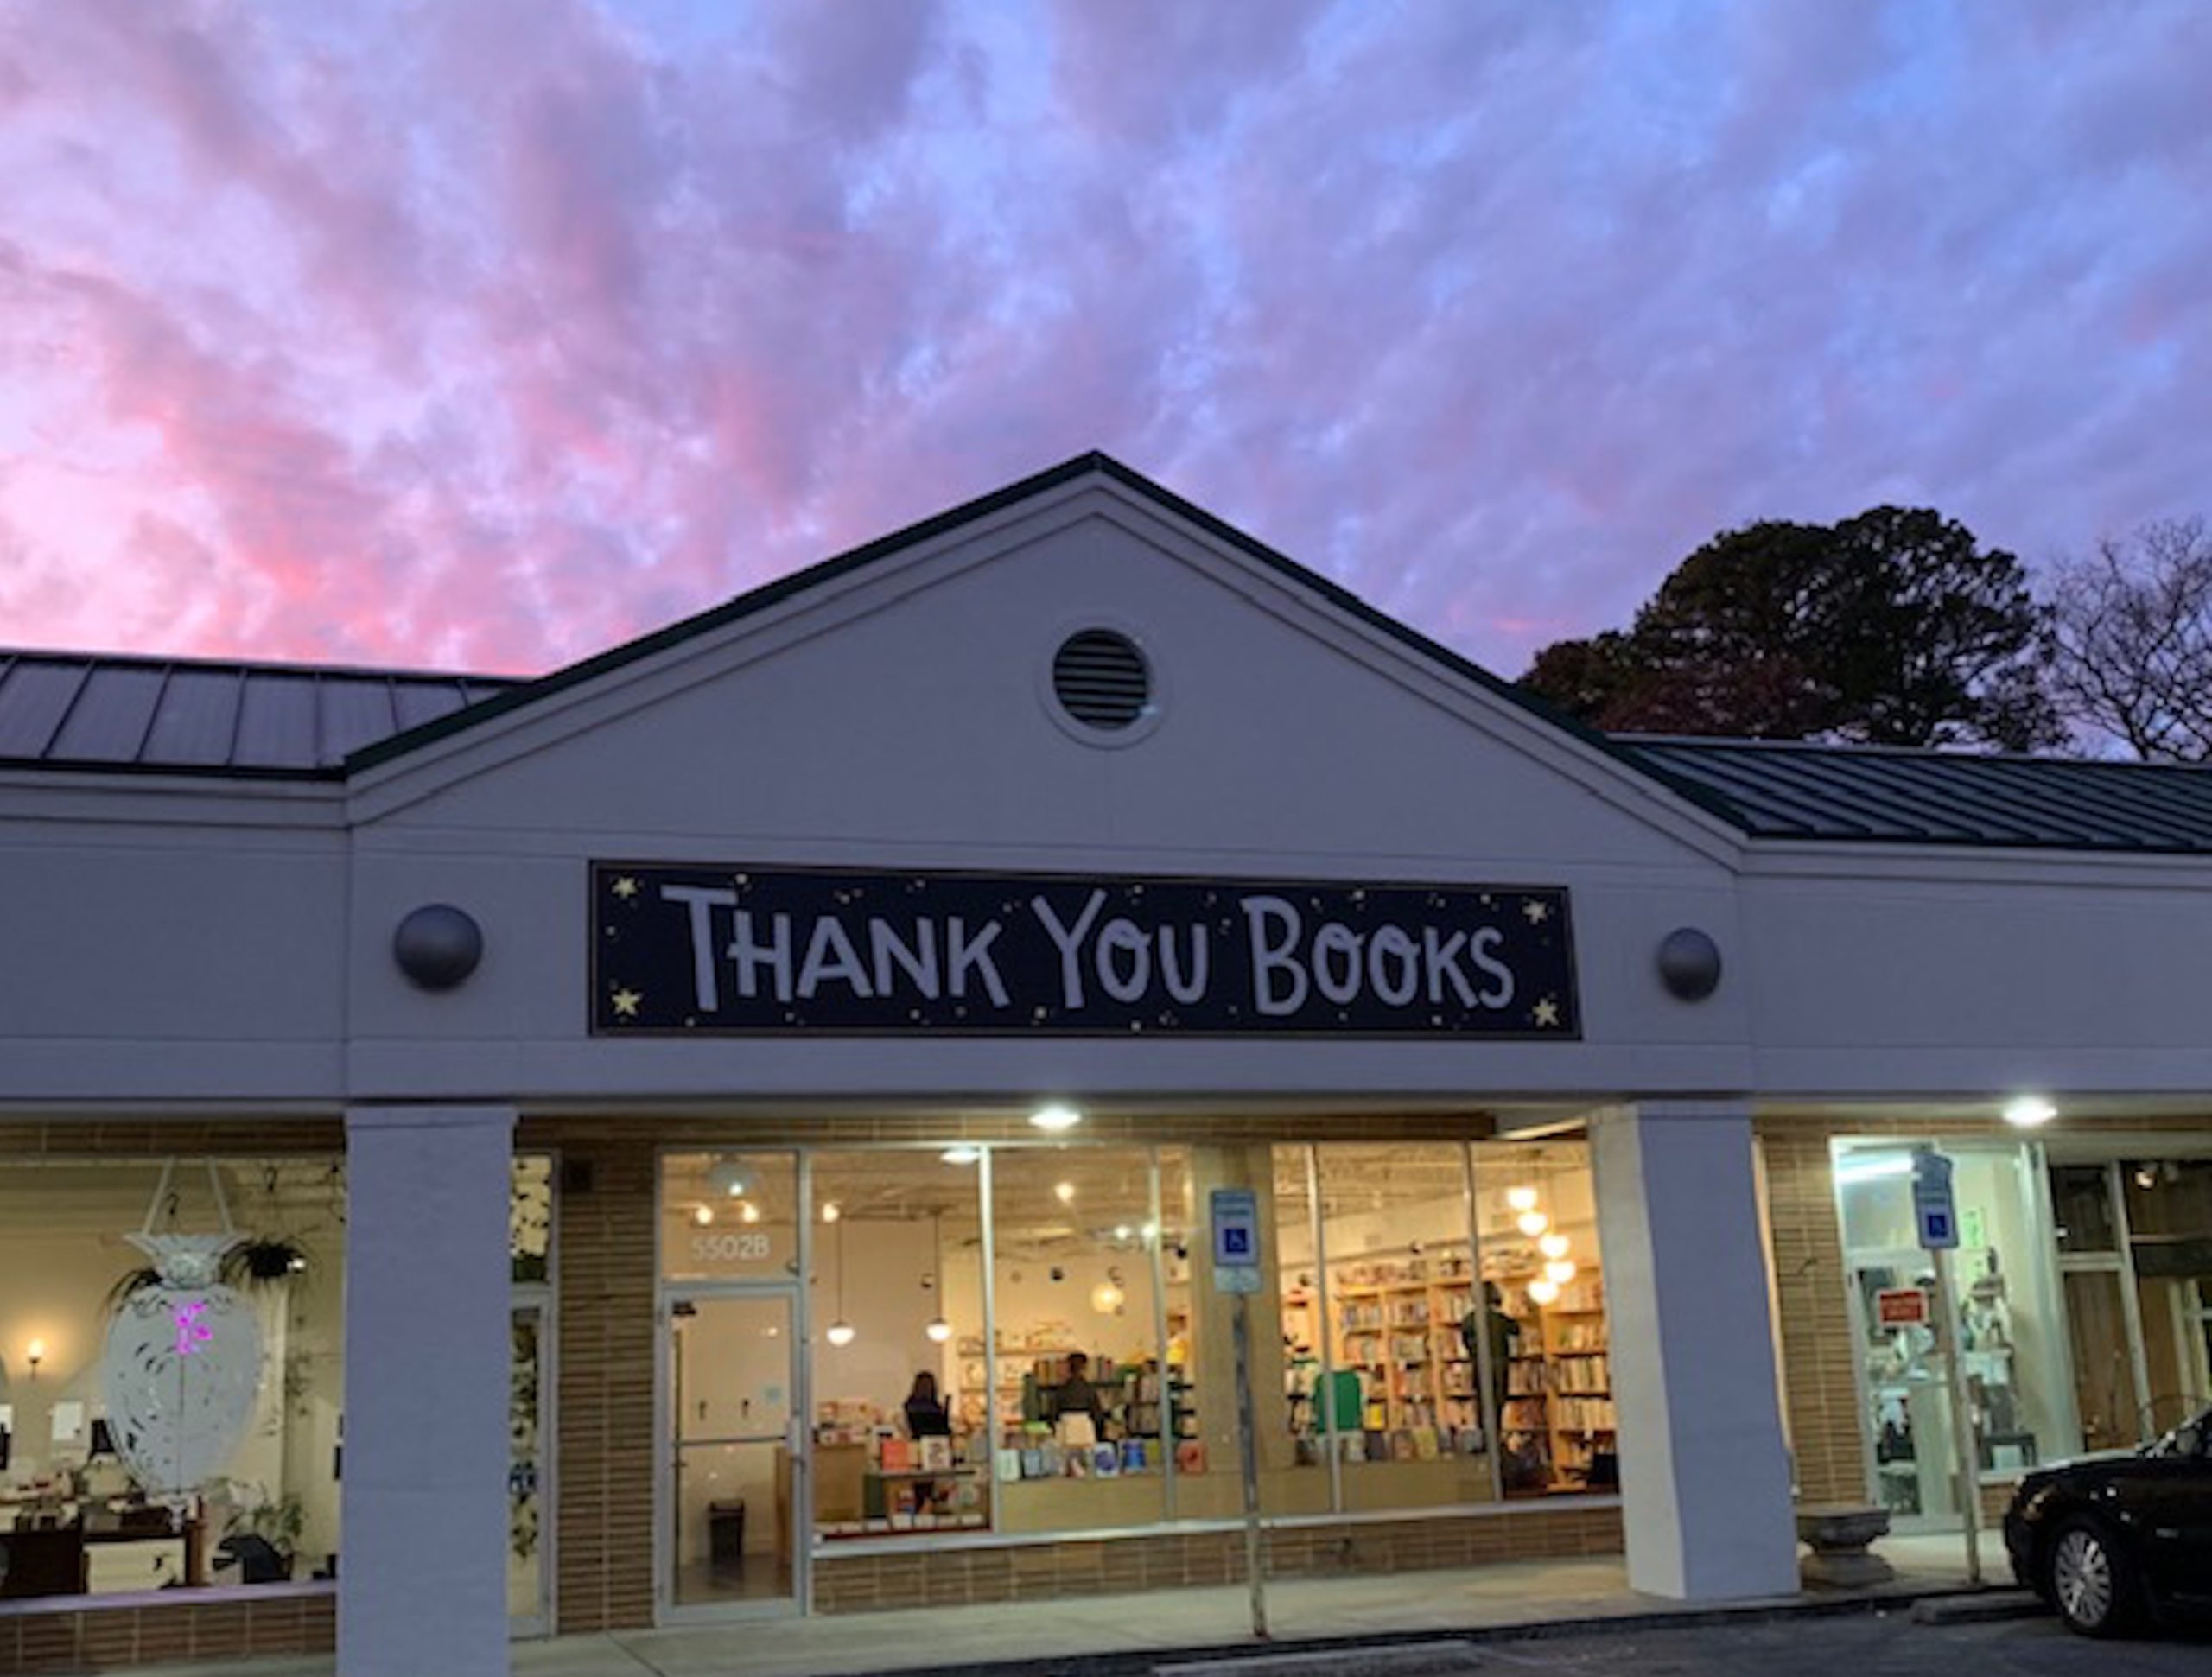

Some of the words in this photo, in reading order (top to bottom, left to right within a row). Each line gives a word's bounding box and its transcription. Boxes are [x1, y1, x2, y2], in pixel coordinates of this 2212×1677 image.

[660, 884, 1011, 1013] THANK
[1031, 889, 1208, 1009] YOU
[1240, 895, 1516, 1016] BOOKS
